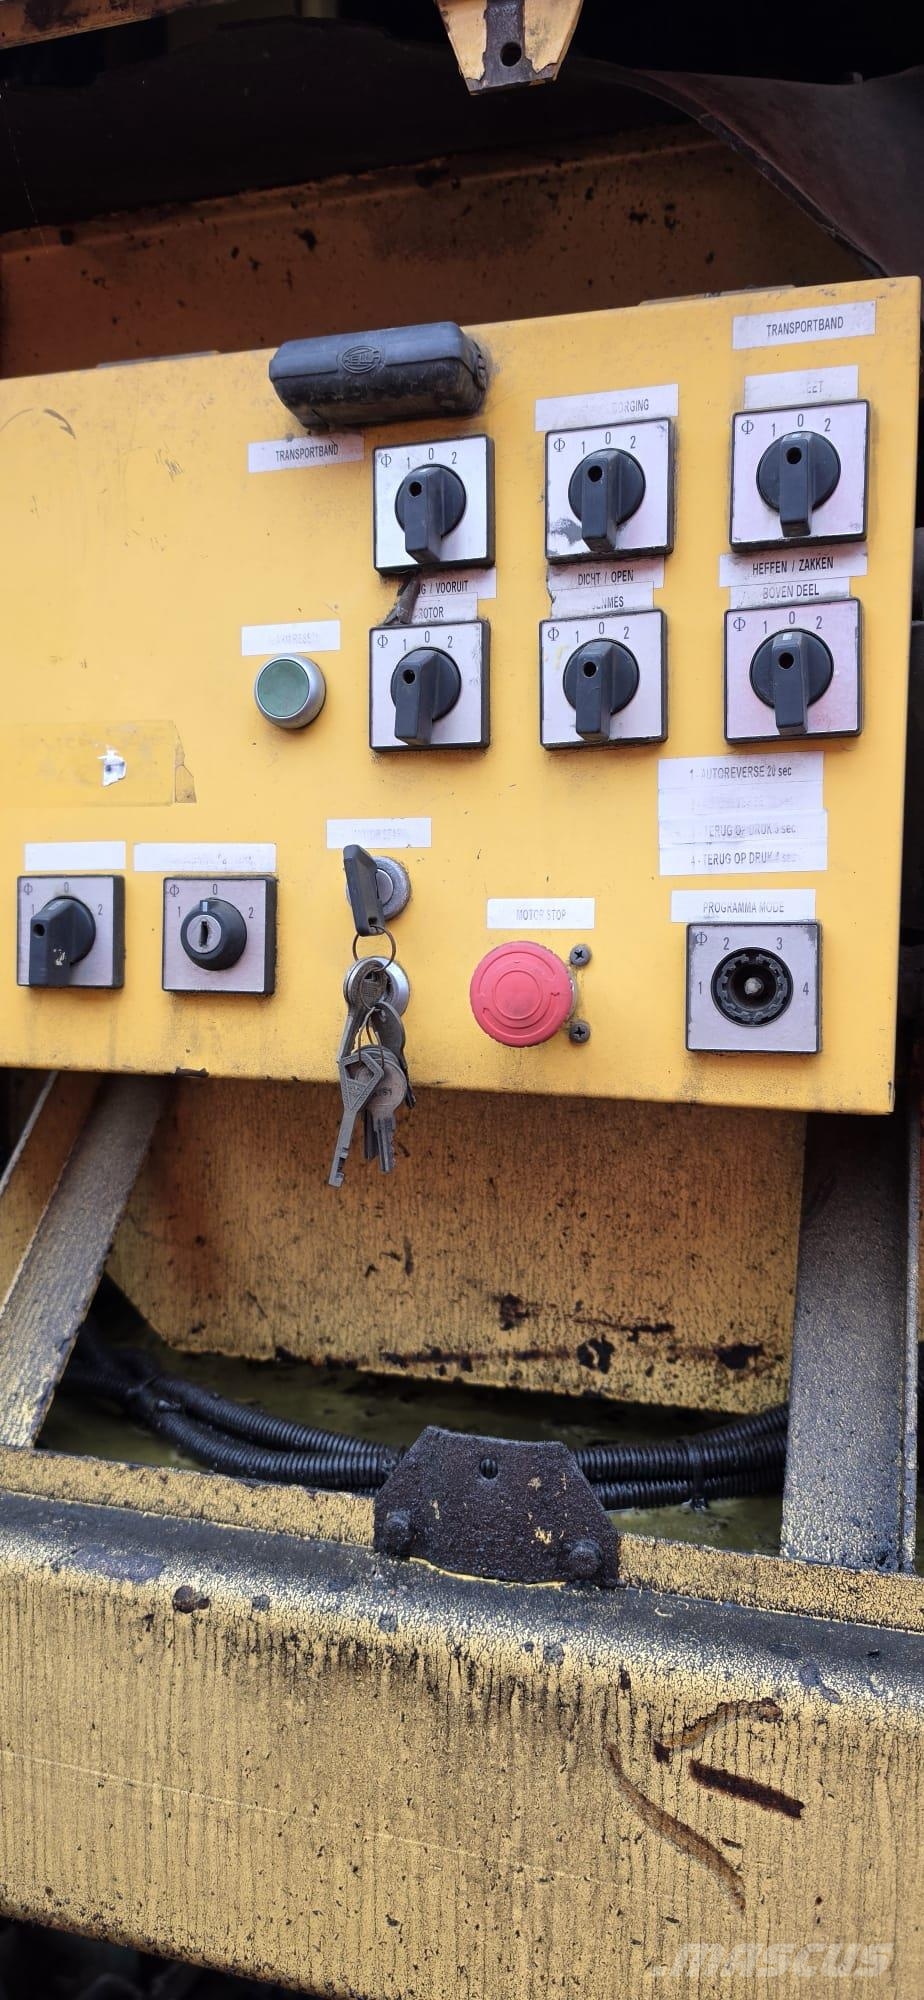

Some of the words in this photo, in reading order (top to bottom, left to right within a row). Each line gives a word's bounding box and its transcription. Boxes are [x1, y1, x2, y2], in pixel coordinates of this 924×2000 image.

[766, 316, 844, 337] TRANSPORTBAND
[275, 443, 339, 463] TRANSPORTBAND
[752, 560, 788, 576] HEFFEN
[798, 556, 834, 572] ZAKKEN
[577, 571, 601, 586] DICHT
[610, 569, 634, 583] OPEN
[435, 580, 469, 594] VOORUIT
[762, 584, 794, 600] BOVEN
[796, 583, 820, 597] DEEL
[701, 766, 765, 780] AUTOREVERSE
[777, 766, 792, 777] sec
[734, 851, 747, 864] OP
